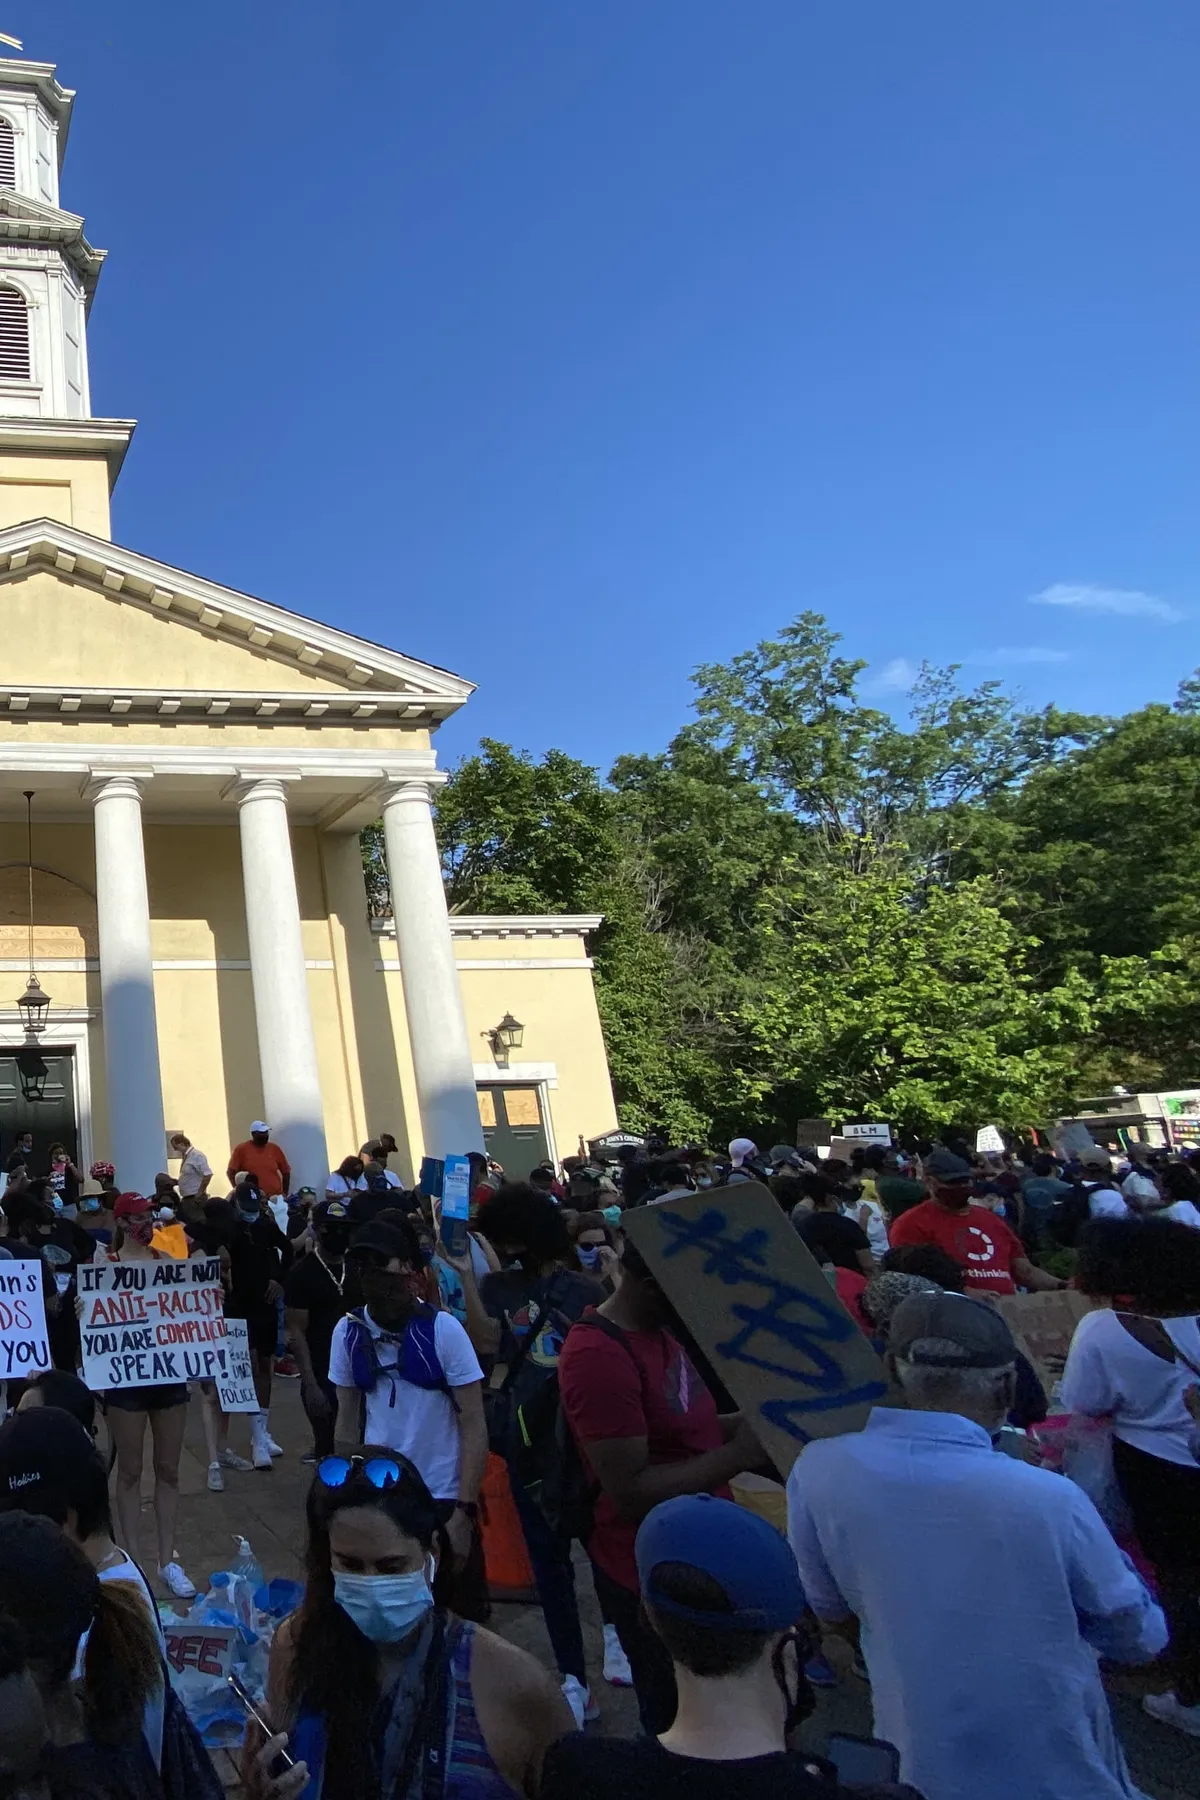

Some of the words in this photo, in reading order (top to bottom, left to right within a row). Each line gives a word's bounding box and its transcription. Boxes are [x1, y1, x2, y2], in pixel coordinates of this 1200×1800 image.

[853, 1126, 877, 1135] BLM
[82, 1267, 106, 1291] IF
[111, 1266, 146, 1291] YOU
[152, 1264, 186, 1286] ARE
[191, 1259, 220, 1283] NOT
[90, 1287, 221, 1325] ANTI-RACIST
[658, 1208, 886, 1443] #BL
[1, 1340, 49, 1373] YOU
[82, 1332, 118, 1357] YOU
[120, 1328, 156, 1353] ARE
[109, 1351, 180, 1384] SPEAK
[183, 1349, 229, 1380] UP!
[221, 1388, 257, 1405] POLICE
[8, 1471, 41, 1490] Hokies
[165, 1635, 228, 1677] REE
